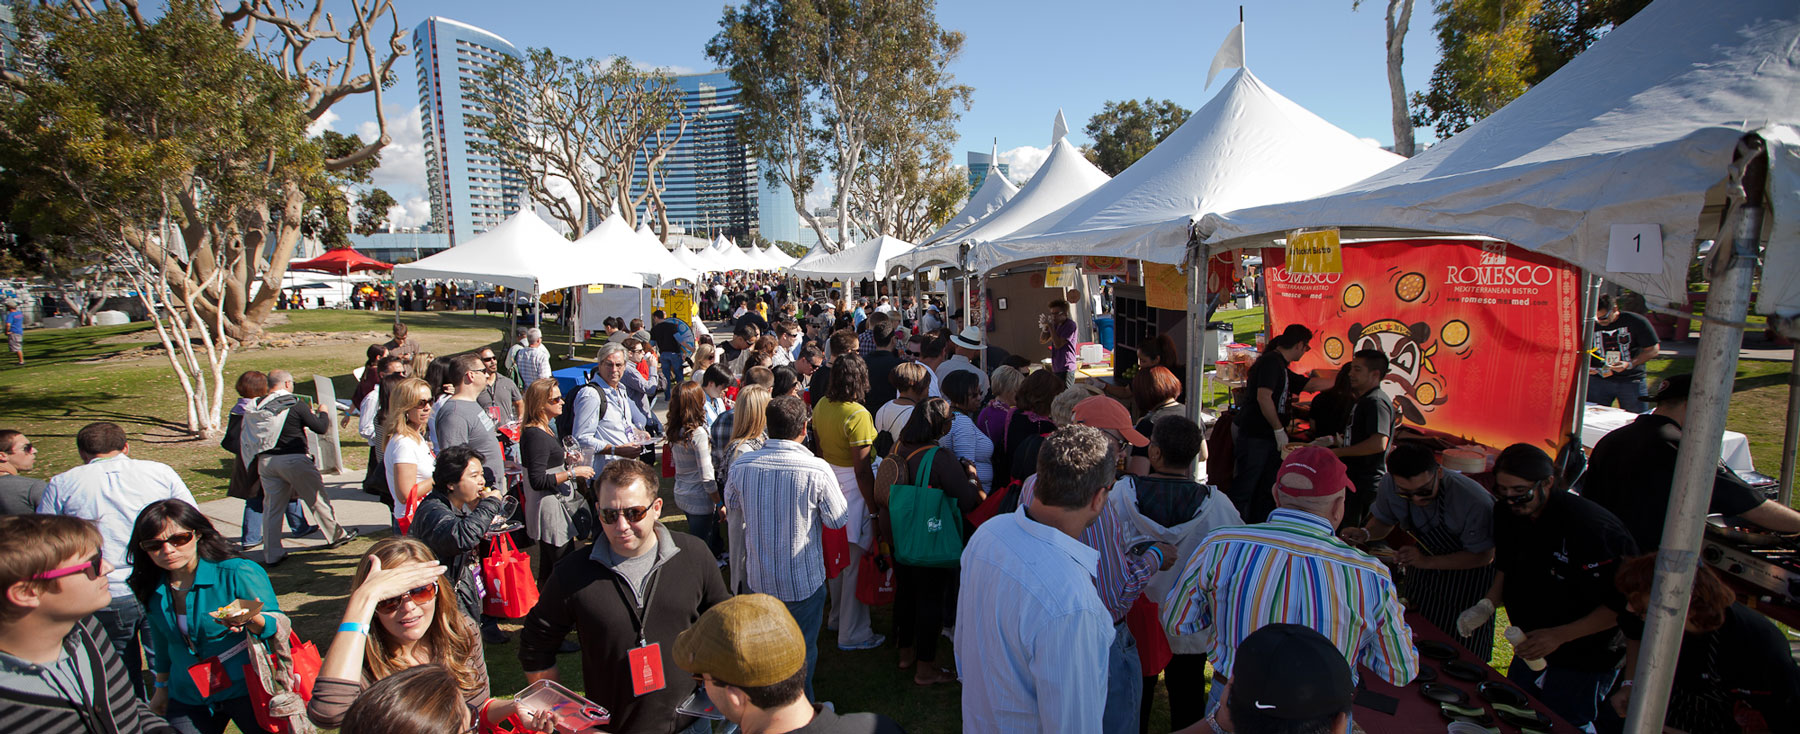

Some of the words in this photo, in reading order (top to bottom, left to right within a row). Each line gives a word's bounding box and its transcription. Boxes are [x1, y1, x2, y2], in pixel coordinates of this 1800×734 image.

[1312, 246, 1332, 255] Bistro
[1633, 233, 1641, 253] 1
[1271, 267, 1341, 284] ROMESCO
[1444, 265, 1553, 285] ROMESCO
[1454, 285, 1511, 294] MEXITERRANEAN
[1512, 287, 1539, 295] BISTRO
